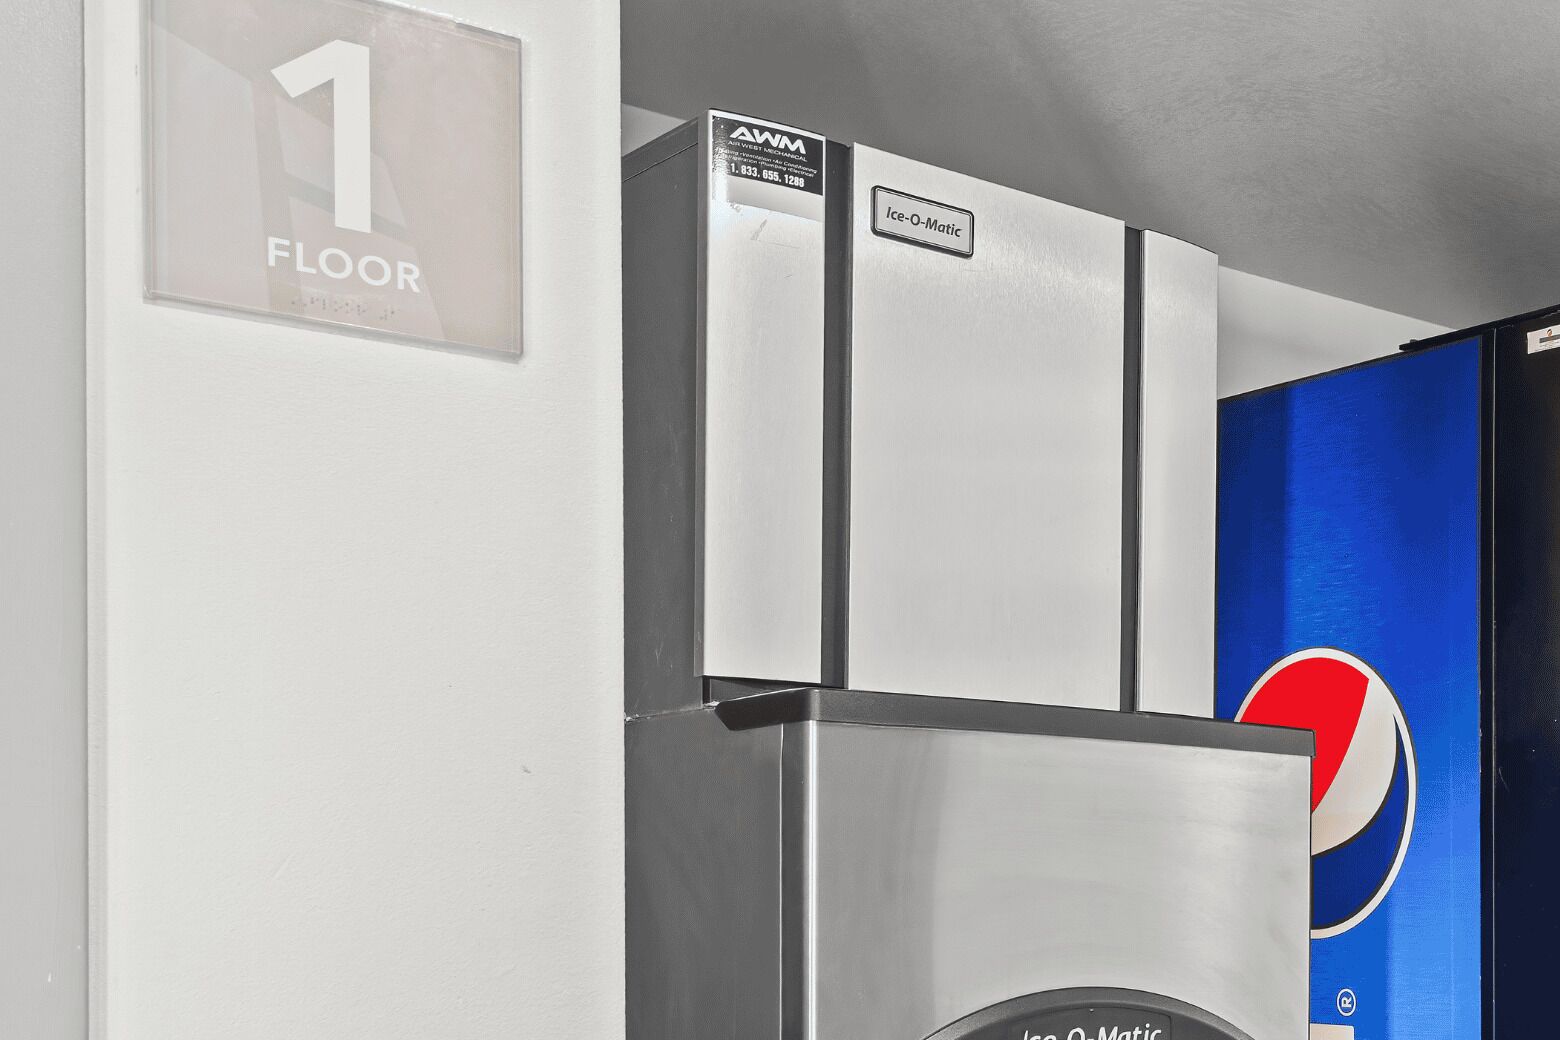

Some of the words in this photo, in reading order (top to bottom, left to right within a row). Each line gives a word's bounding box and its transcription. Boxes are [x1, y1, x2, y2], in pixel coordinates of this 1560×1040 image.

[270, 39, 372, 233] 1
[729, 126, 807, 155] AWM
[741, 143, 763, 151] WEST
[764, 147, 808, 162] MECHANICAL
[762, 169, 782, 183] 655.
[784, 174, 805, 188] 1288
[886, 206, 962, 238] Ice-O-Matic
[267, 237, 422, 293] FLOOR
